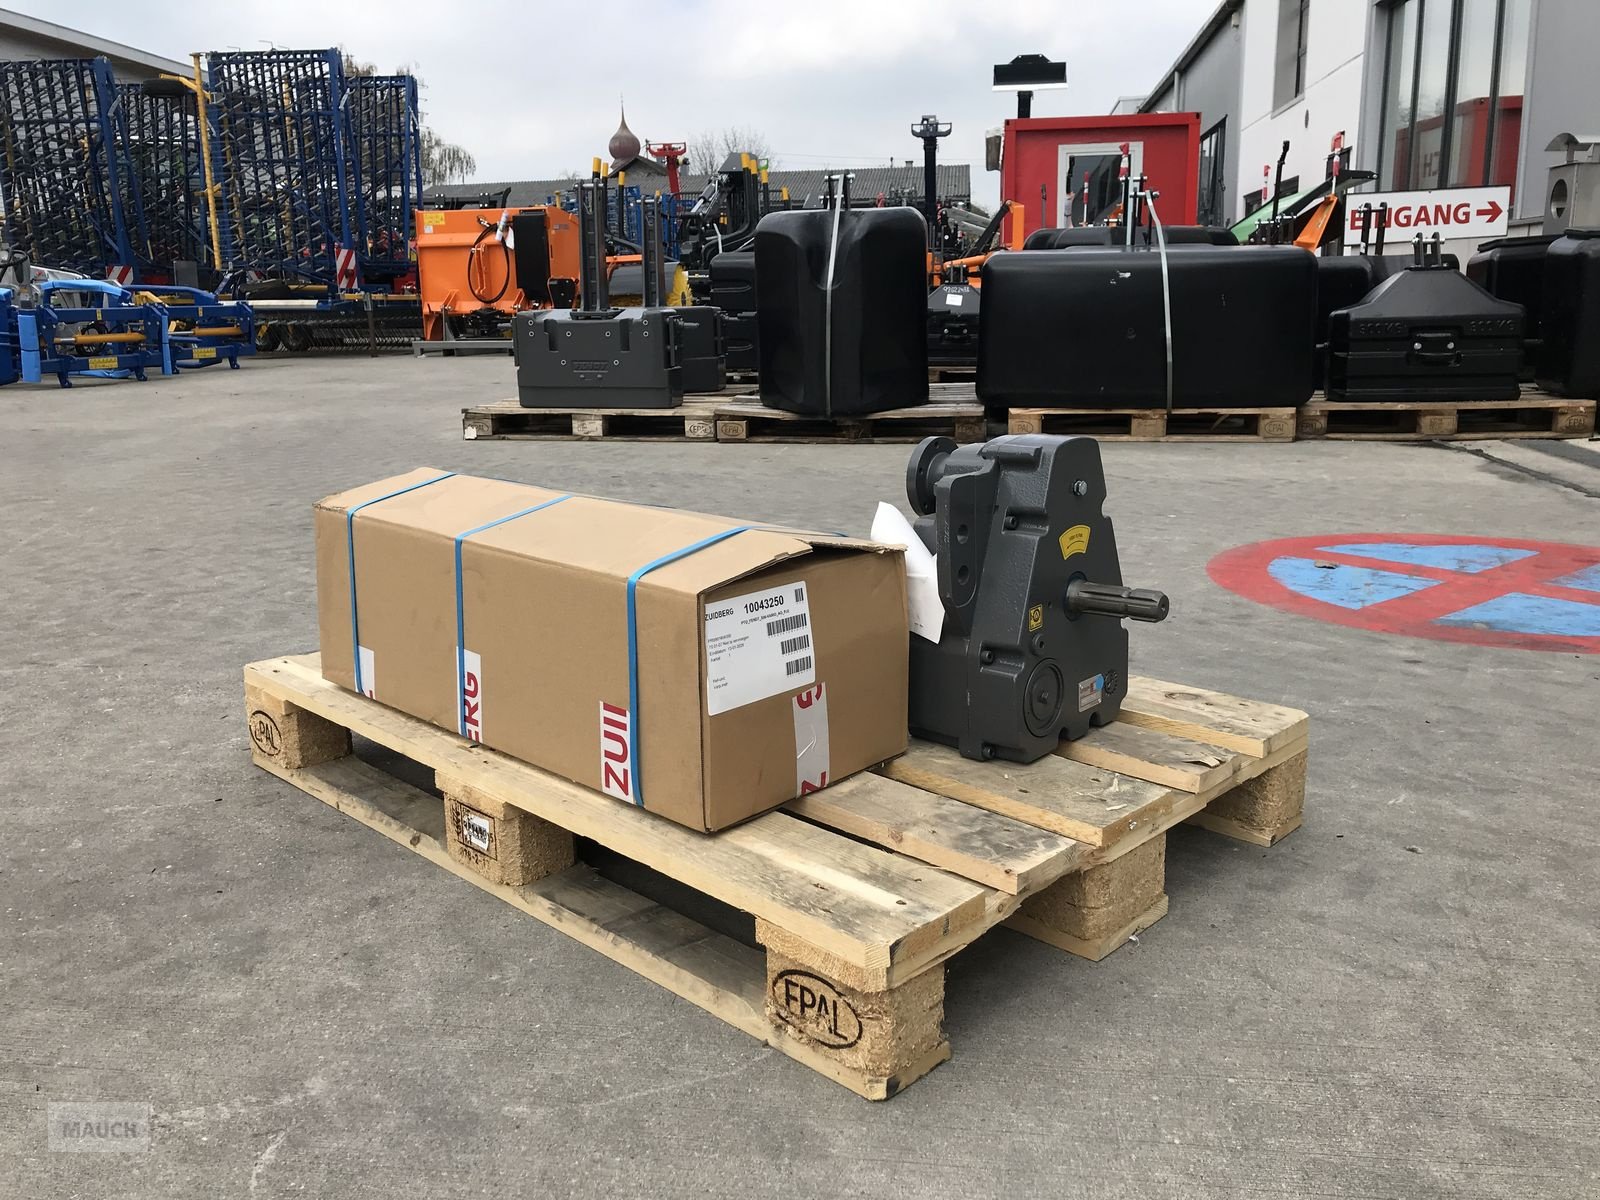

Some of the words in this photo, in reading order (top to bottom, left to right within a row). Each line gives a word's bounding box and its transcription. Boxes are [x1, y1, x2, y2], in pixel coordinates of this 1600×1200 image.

[1350, 203, 1470, 230] ENGANG
[744, 595, 784, 614] 10043250
[704, 608, 734, 621] ZUIDBERG
